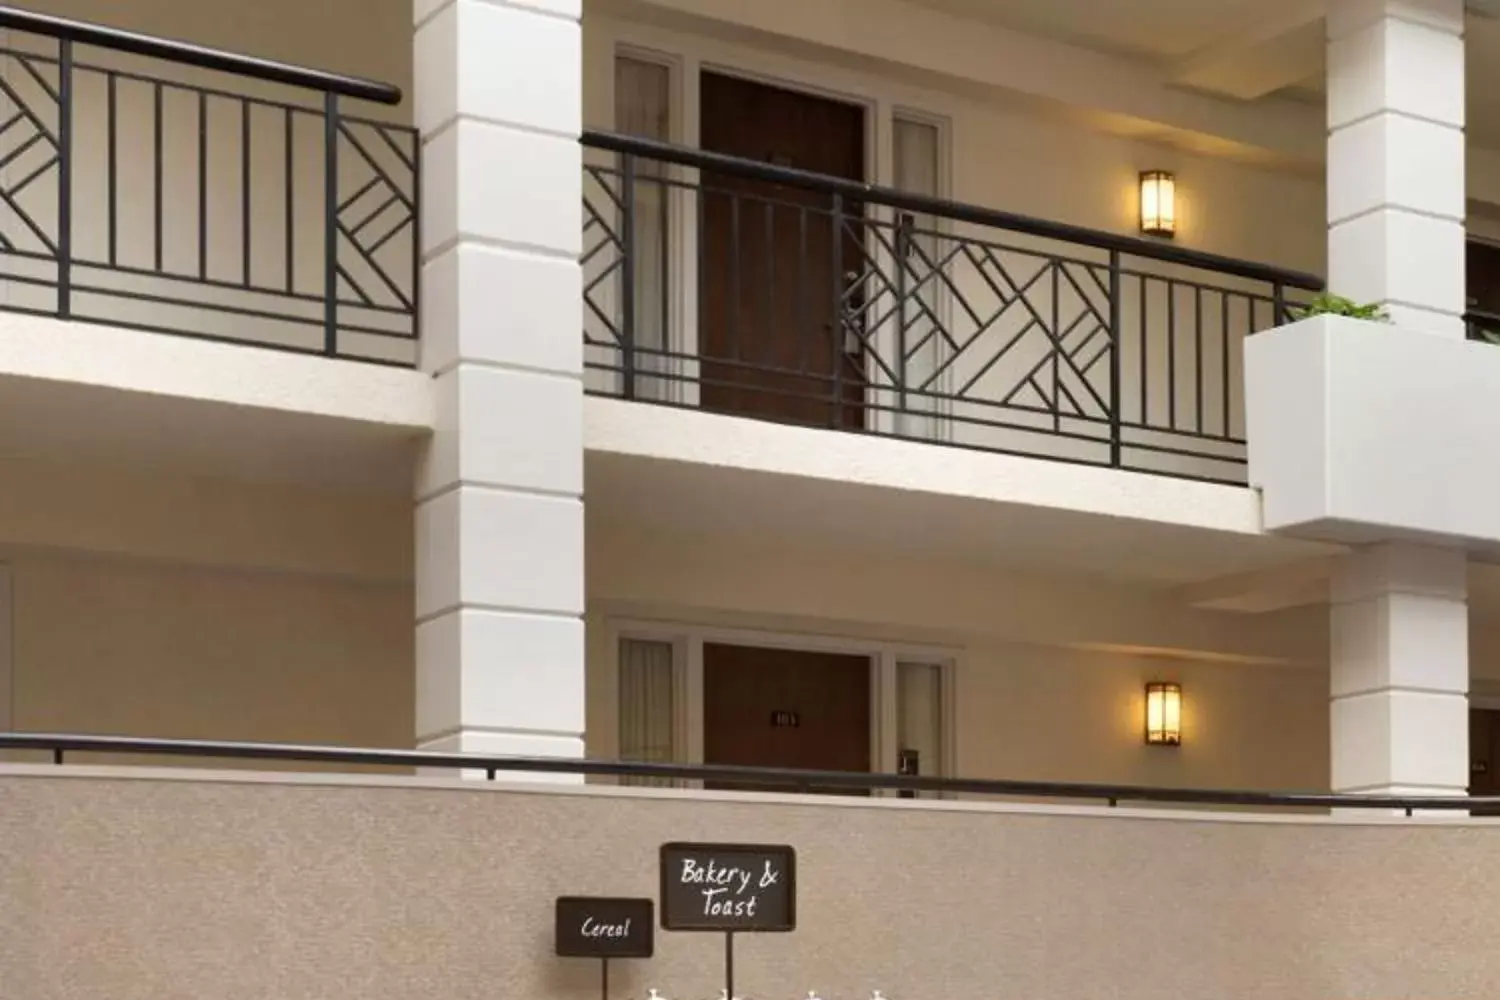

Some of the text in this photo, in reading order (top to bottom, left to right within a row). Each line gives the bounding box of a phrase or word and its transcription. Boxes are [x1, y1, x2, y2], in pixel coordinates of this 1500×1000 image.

[681, 858, 780, 894] Bakery &
[701, 887, 758, 917] Toast
[580, 916, 631, 937] Cereal
